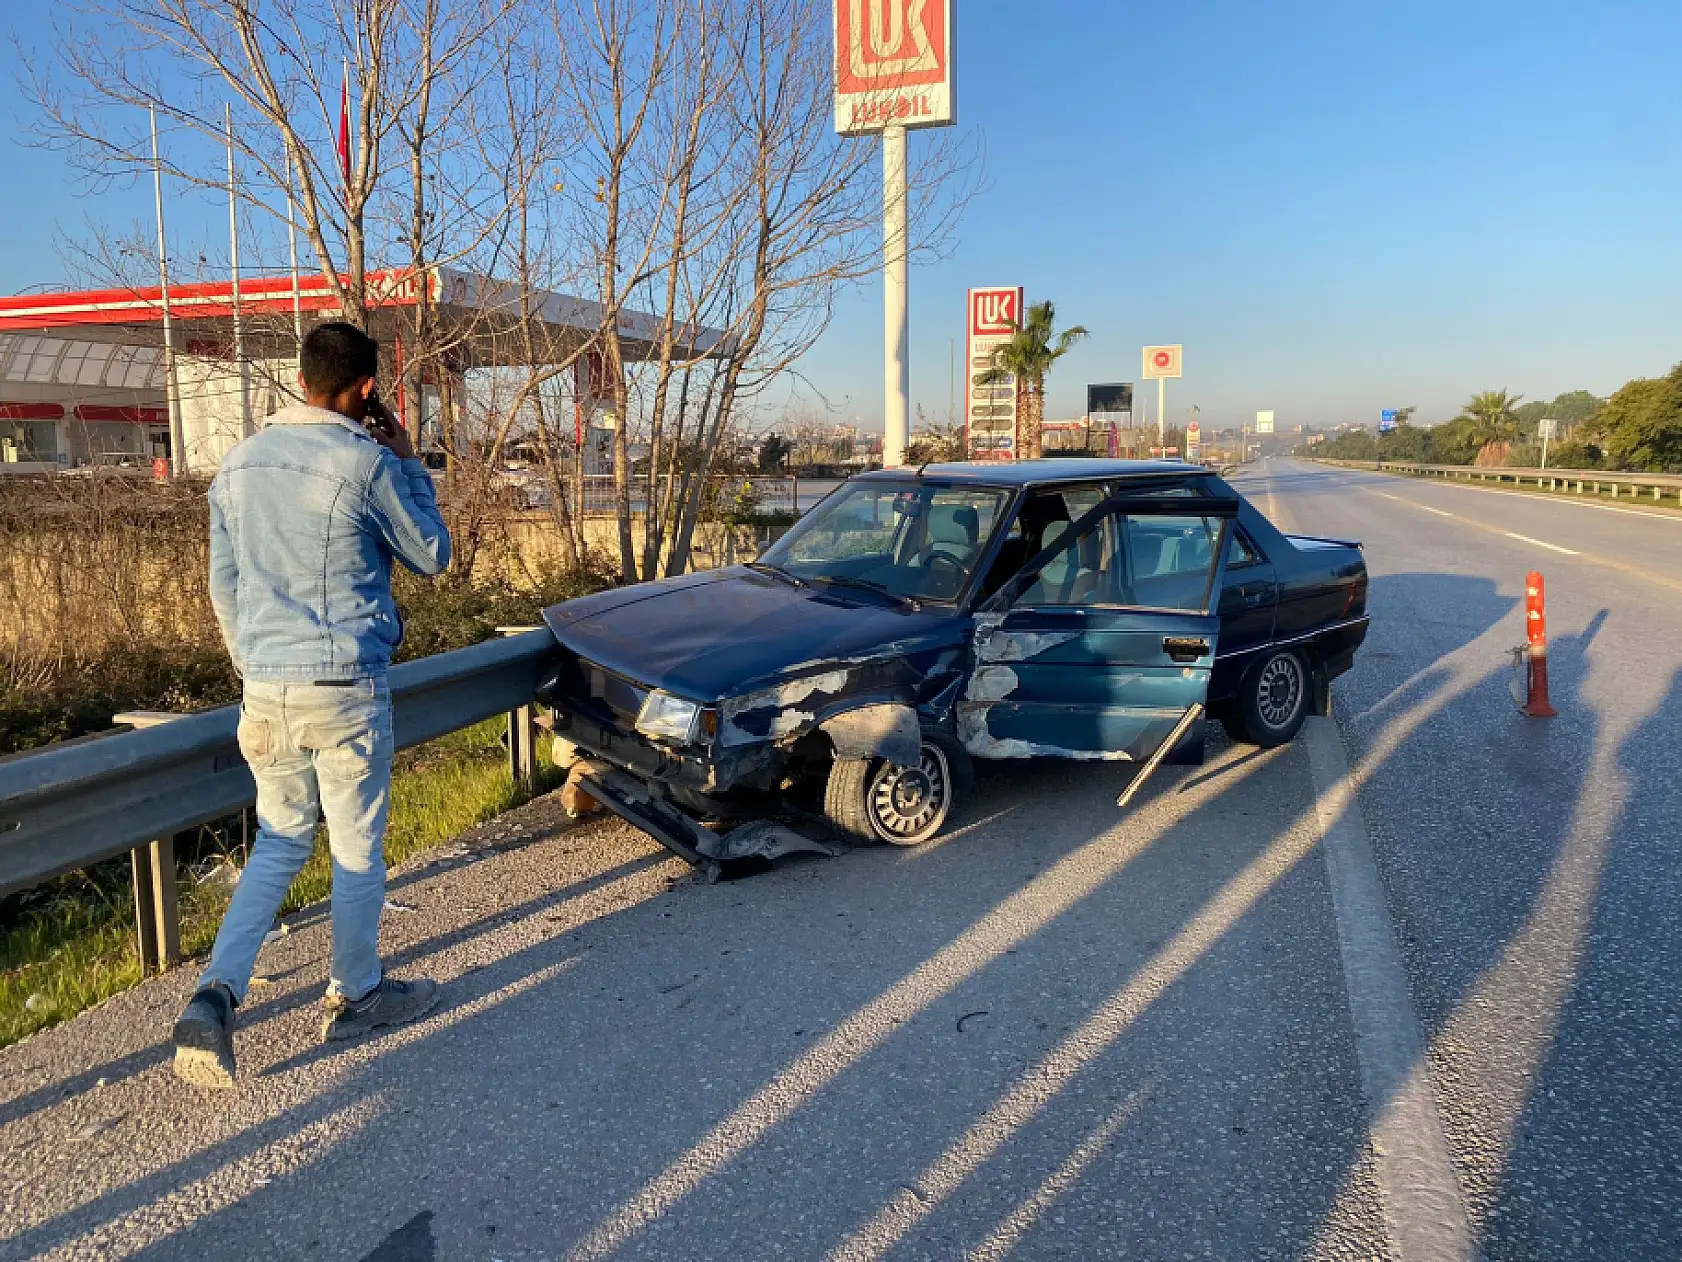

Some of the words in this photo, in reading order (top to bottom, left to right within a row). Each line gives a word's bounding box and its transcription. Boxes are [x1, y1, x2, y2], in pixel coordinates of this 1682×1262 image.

[849, 0, 940, 78] LUK
[851, 95, 931, 124] LUKOIL
[977, 293, 1012, 330] LUK
